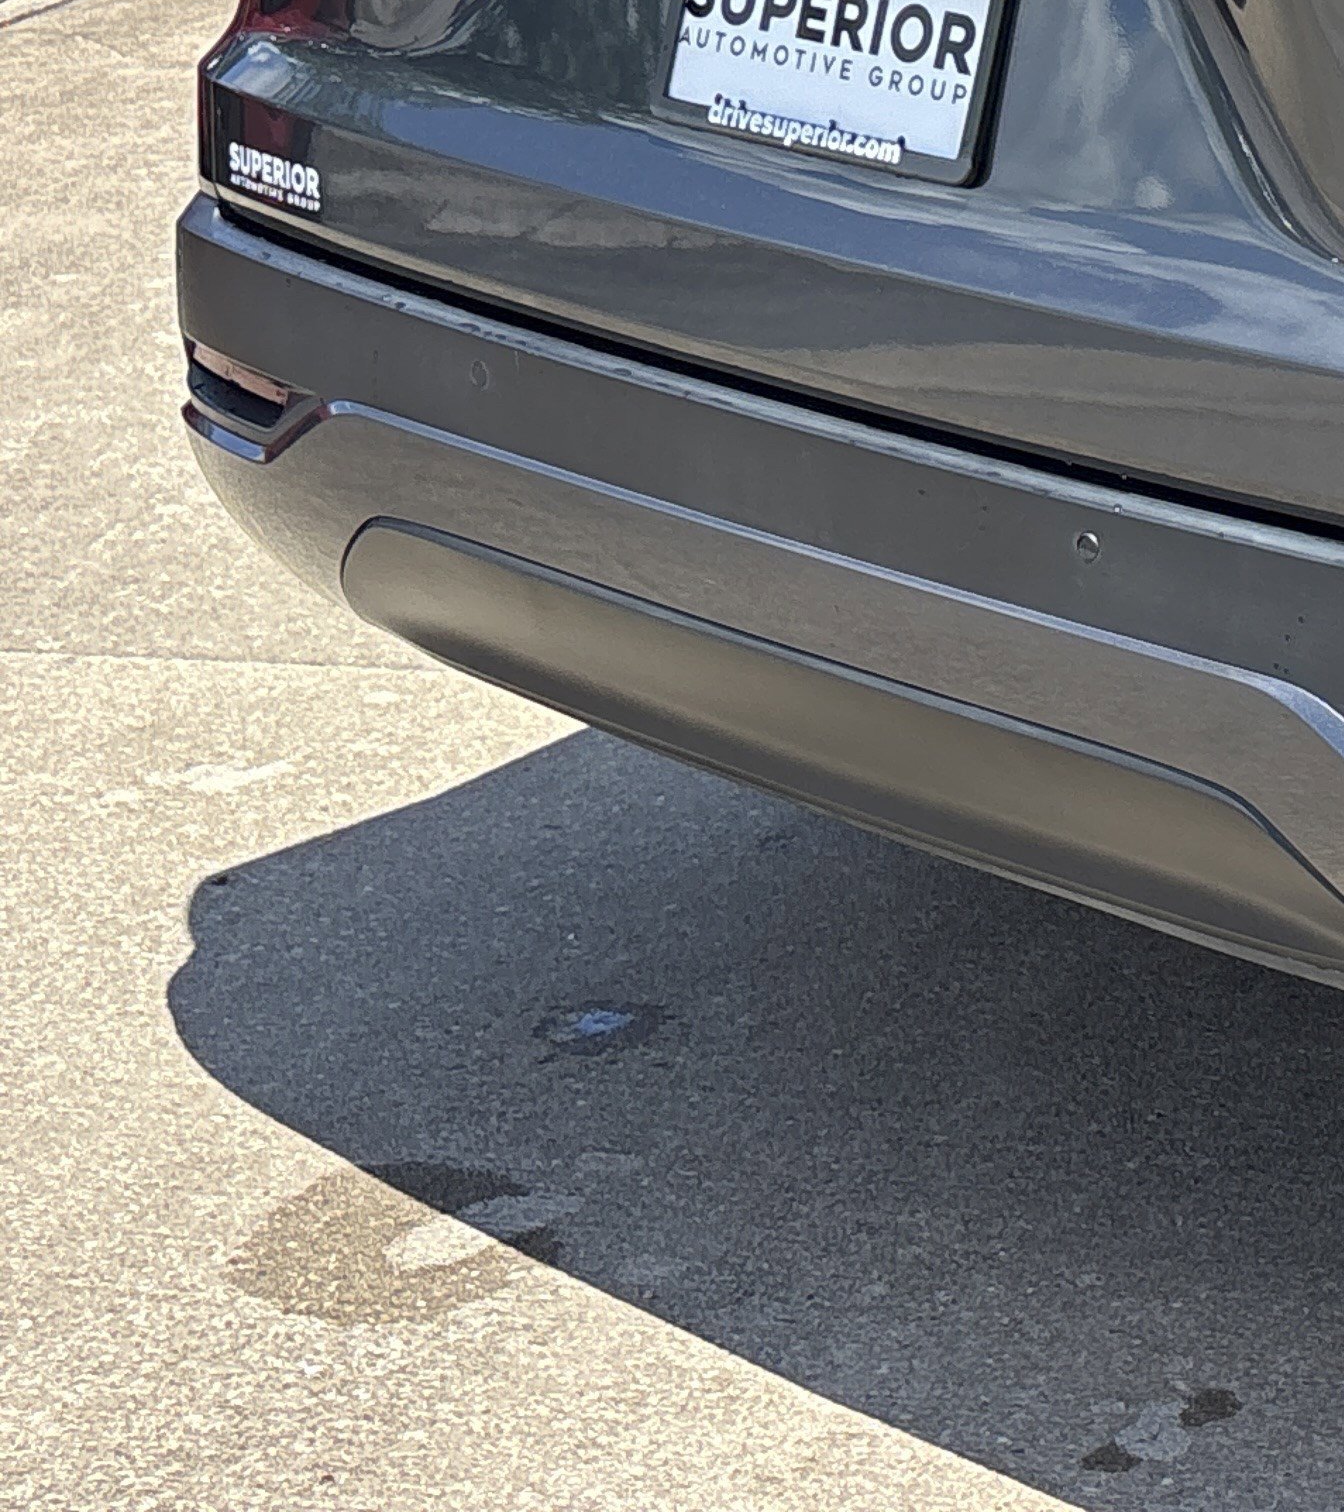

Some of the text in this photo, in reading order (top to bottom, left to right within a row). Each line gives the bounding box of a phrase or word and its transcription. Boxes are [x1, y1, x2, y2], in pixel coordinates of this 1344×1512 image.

[678, 26, 968, 105] AUTOMOTIVE GROUP
[708, 101, 901, 164] drivesuperior.com
[229, 141, 320, 199] SUPERIOR
